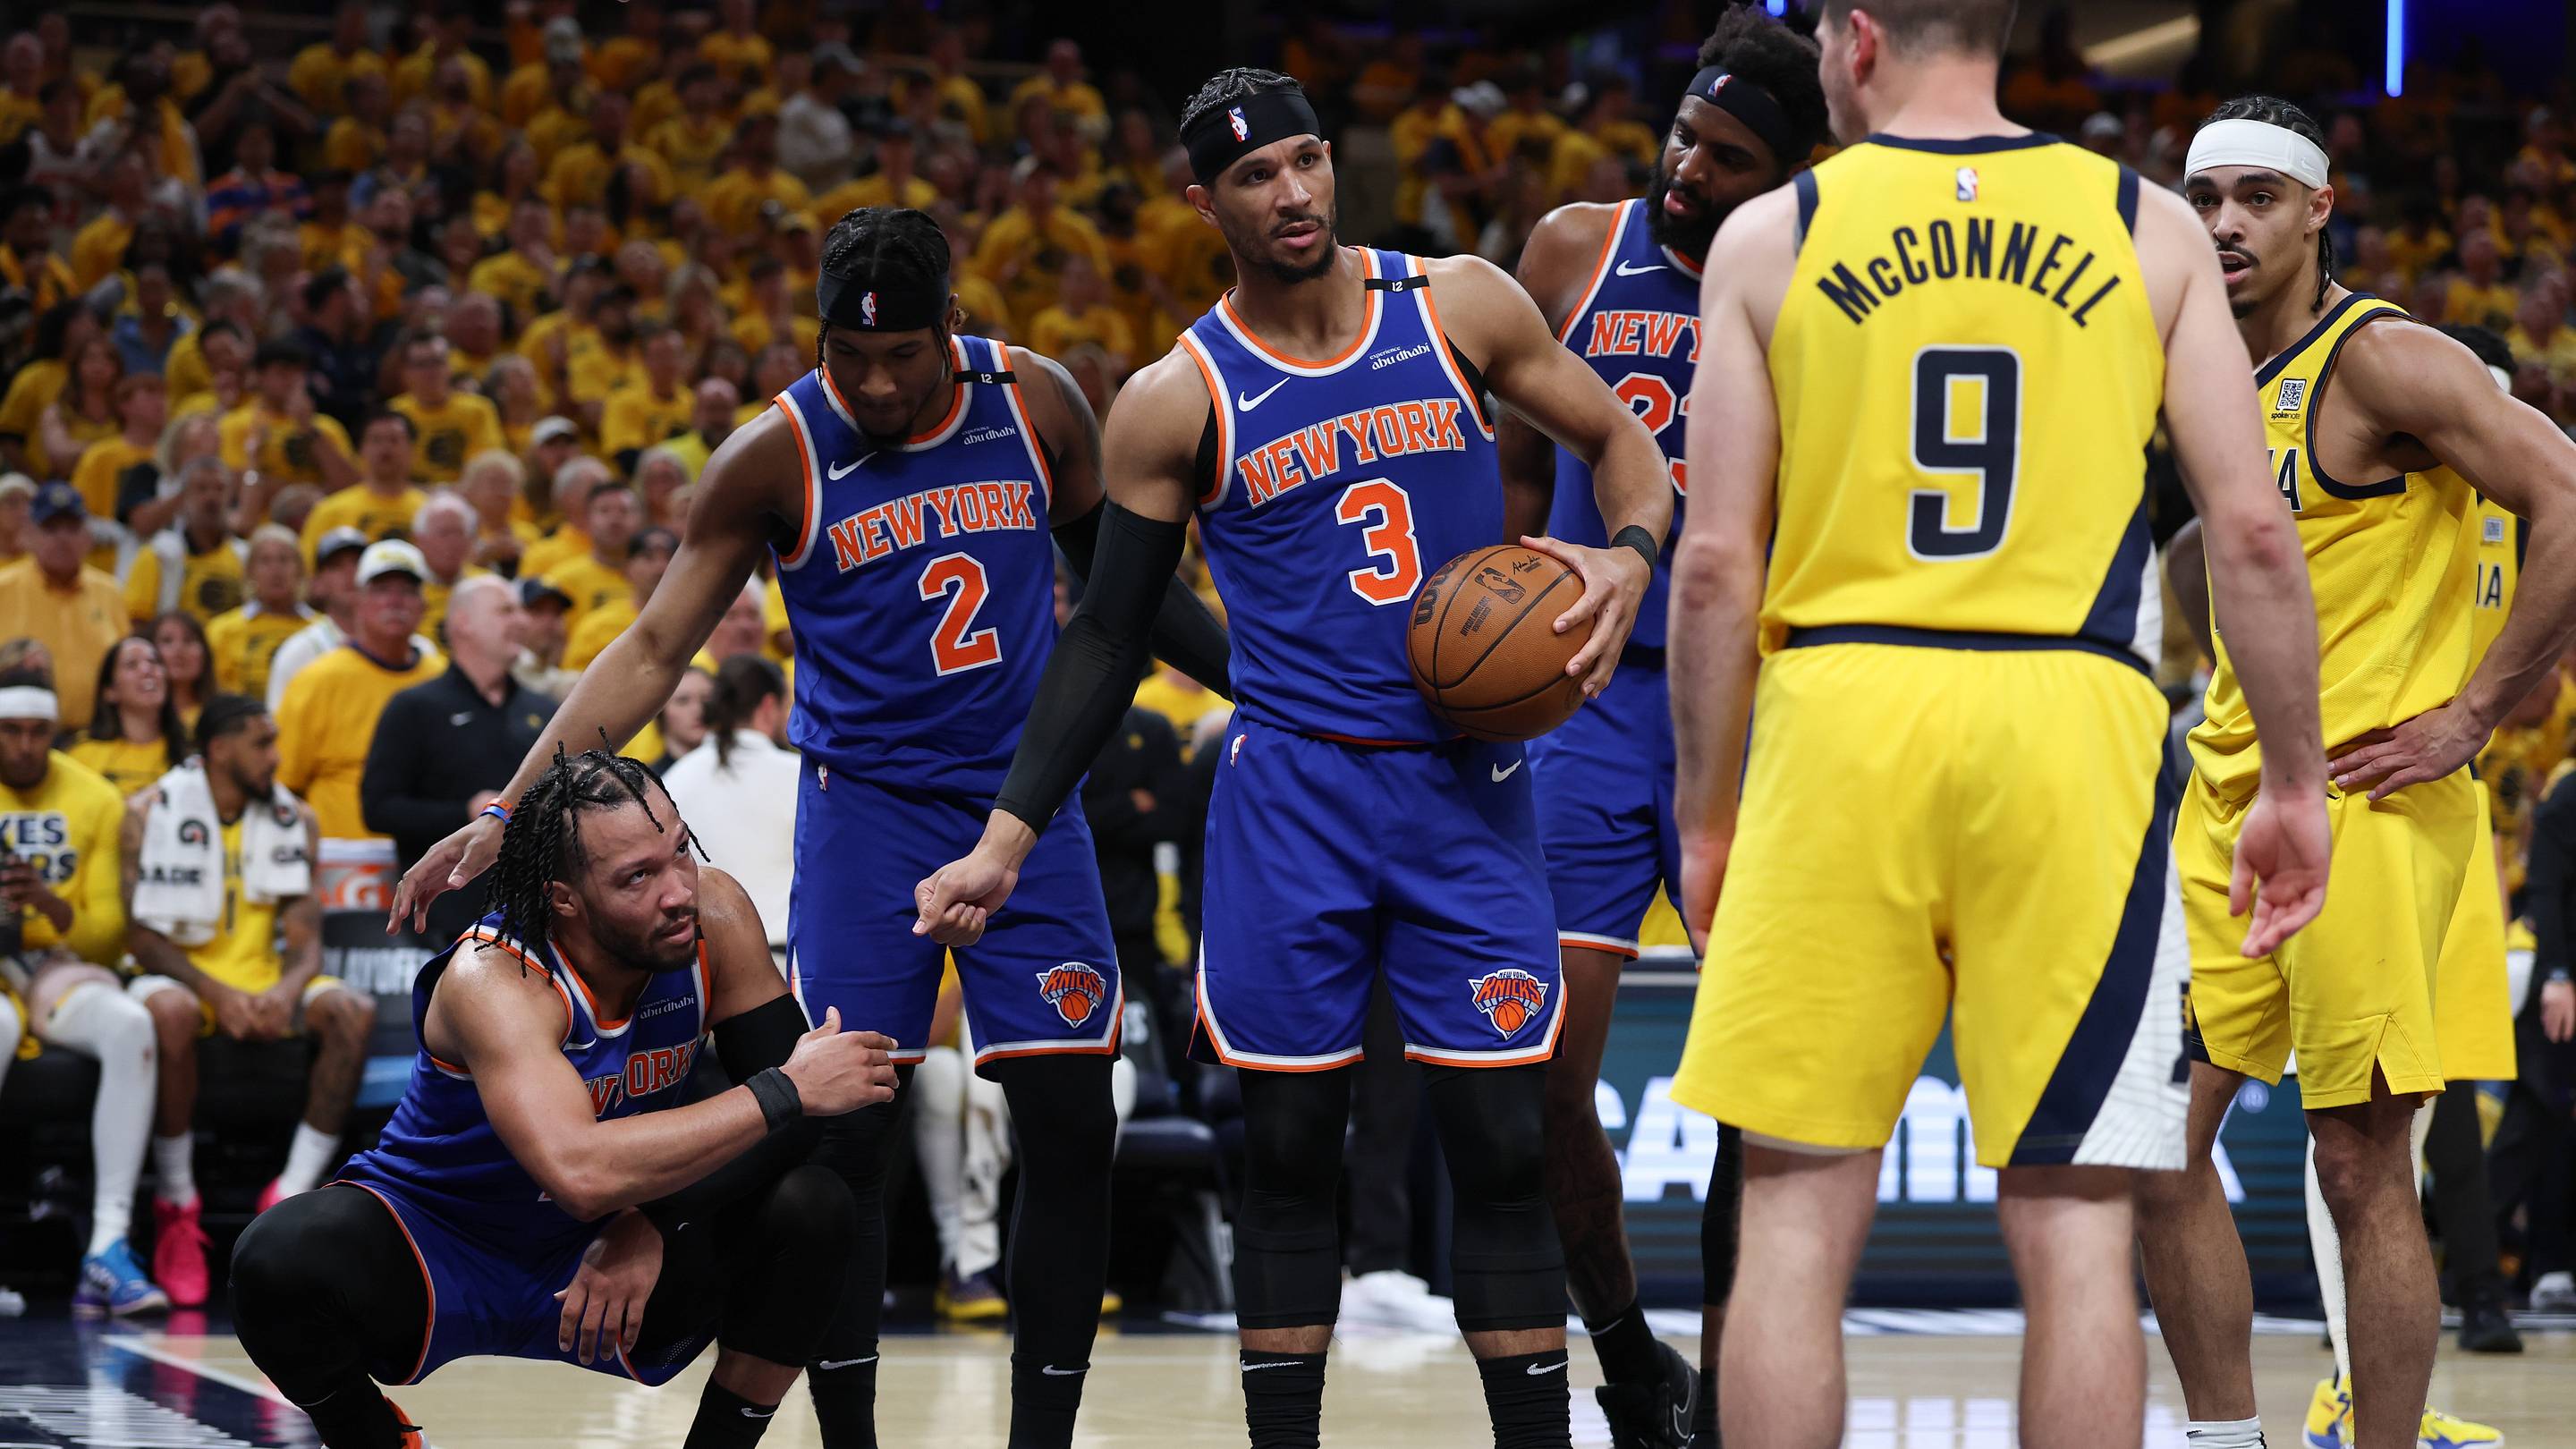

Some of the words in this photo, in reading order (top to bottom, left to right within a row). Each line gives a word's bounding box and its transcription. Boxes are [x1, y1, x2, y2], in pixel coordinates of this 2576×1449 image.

[1391, 281, 1403, 292] 12
[1817, 217, 2121, 328] McCONNELL
[1586, 310, 1688, 358] NEW
[1369, 346, 1401, 360] experience
[1372, 356, 1395, 370] abu
[1396, 342, 1431, 361] dhabi
[980, 373, 993, 384] 12
[2271, 411, 2301, 420] spokenote
[964, 434, 985, 445] abu
[986, 425, 1016, 441] dhabi
[1235, 416, 1341, 509] NEW
[1337, 397, 1467, 466] YORK
[1906, 343, 2022, 562] 9
[826, 494, 925, 574] NEW
[927, 479, 1037, 538] YORK
[1335, 477, 1423, 606] 3
[918, 551, 1003, 677] 2
[1043, 970, 1102, 998] KNICKS
[1476, 977, 1542, 1006] KNICKS
[640, 1007, 662, 1019] abu
[664, 995, 695, 1013] dhabi
